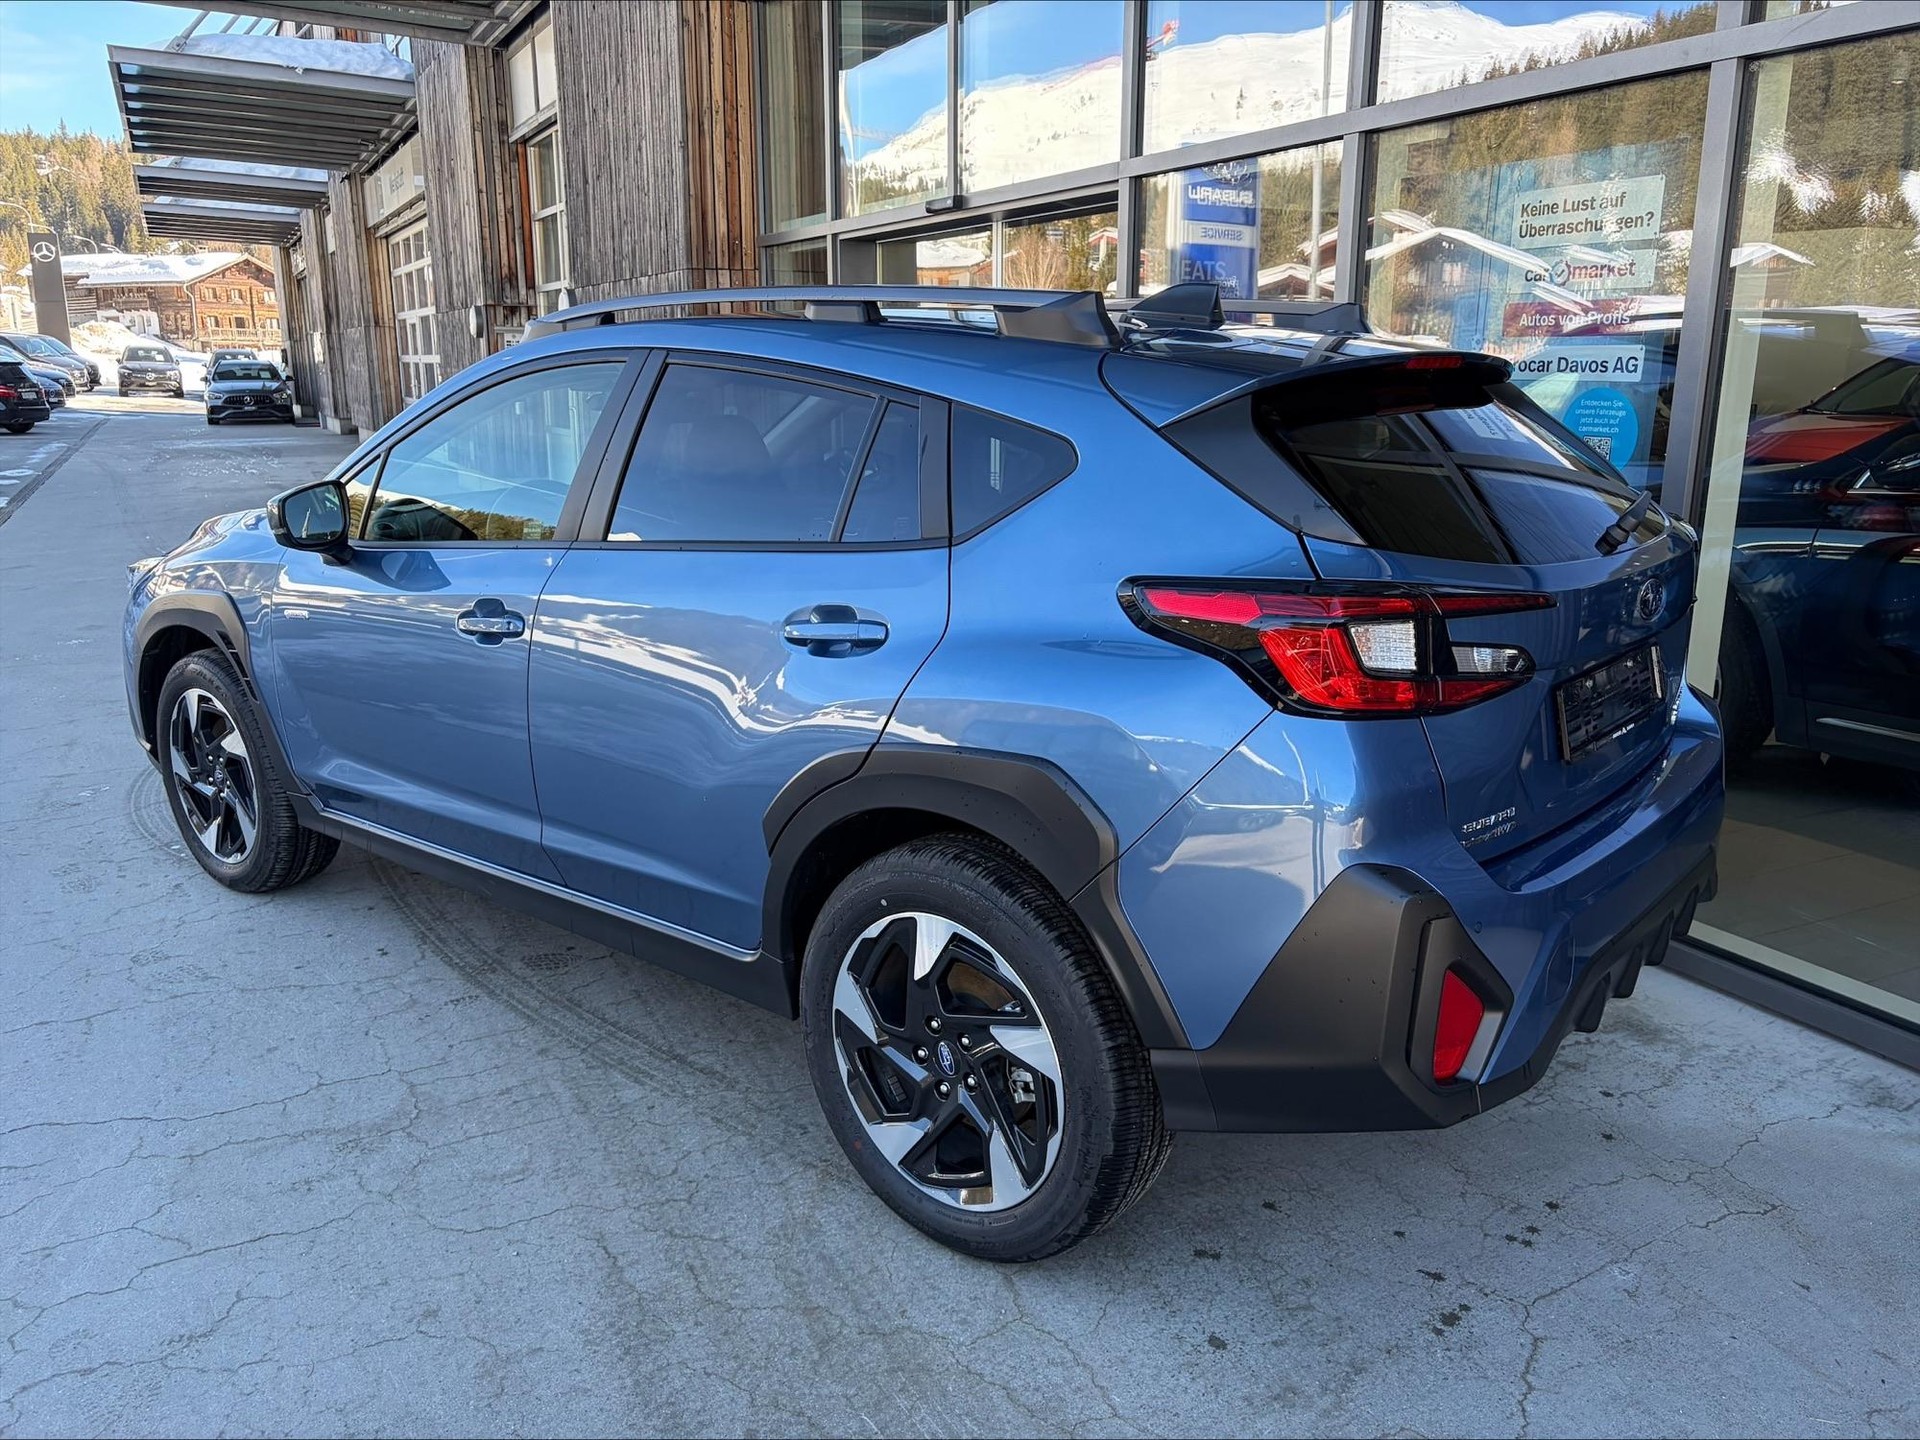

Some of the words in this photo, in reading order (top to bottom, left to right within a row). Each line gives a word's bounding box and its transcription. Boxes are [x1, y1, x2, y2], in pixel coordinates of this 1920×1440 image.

[1520, 200, 1559, 218] Keine
[1562, 196, 1596, 214] Lust
[1599, 191, 1627, 209] auf
[1518, 211, 1655, 239] Überraschugen?
[1519, 312, 1556, 327] Autos
[1586, 310, 1630, 326] Profis
[1556, 356, 1609, 374] Davos
[1612, 356, 1639, 374] AG
[1580, 399, 1612, 407] Entdecken
[1595, 408, 1627, 418] Fahrzeuge
